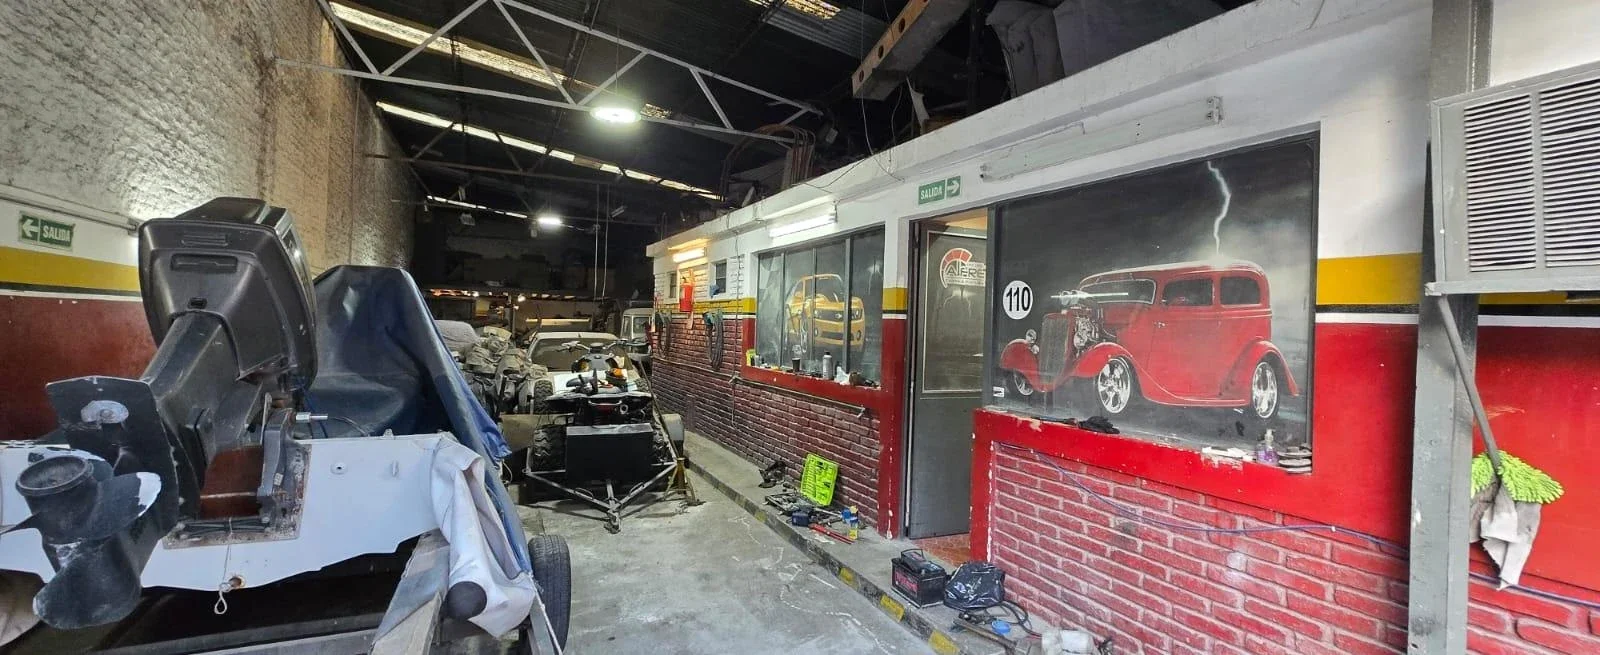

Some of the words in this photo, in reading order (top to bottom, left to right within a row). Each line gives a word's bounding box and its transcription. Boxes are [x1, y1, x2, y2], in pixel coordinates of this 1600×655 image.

[920, 185, 943, 200] SALIDA
[42, 224, 71, 242] SALIDA
[1006, 286, 1031, 311] 110
